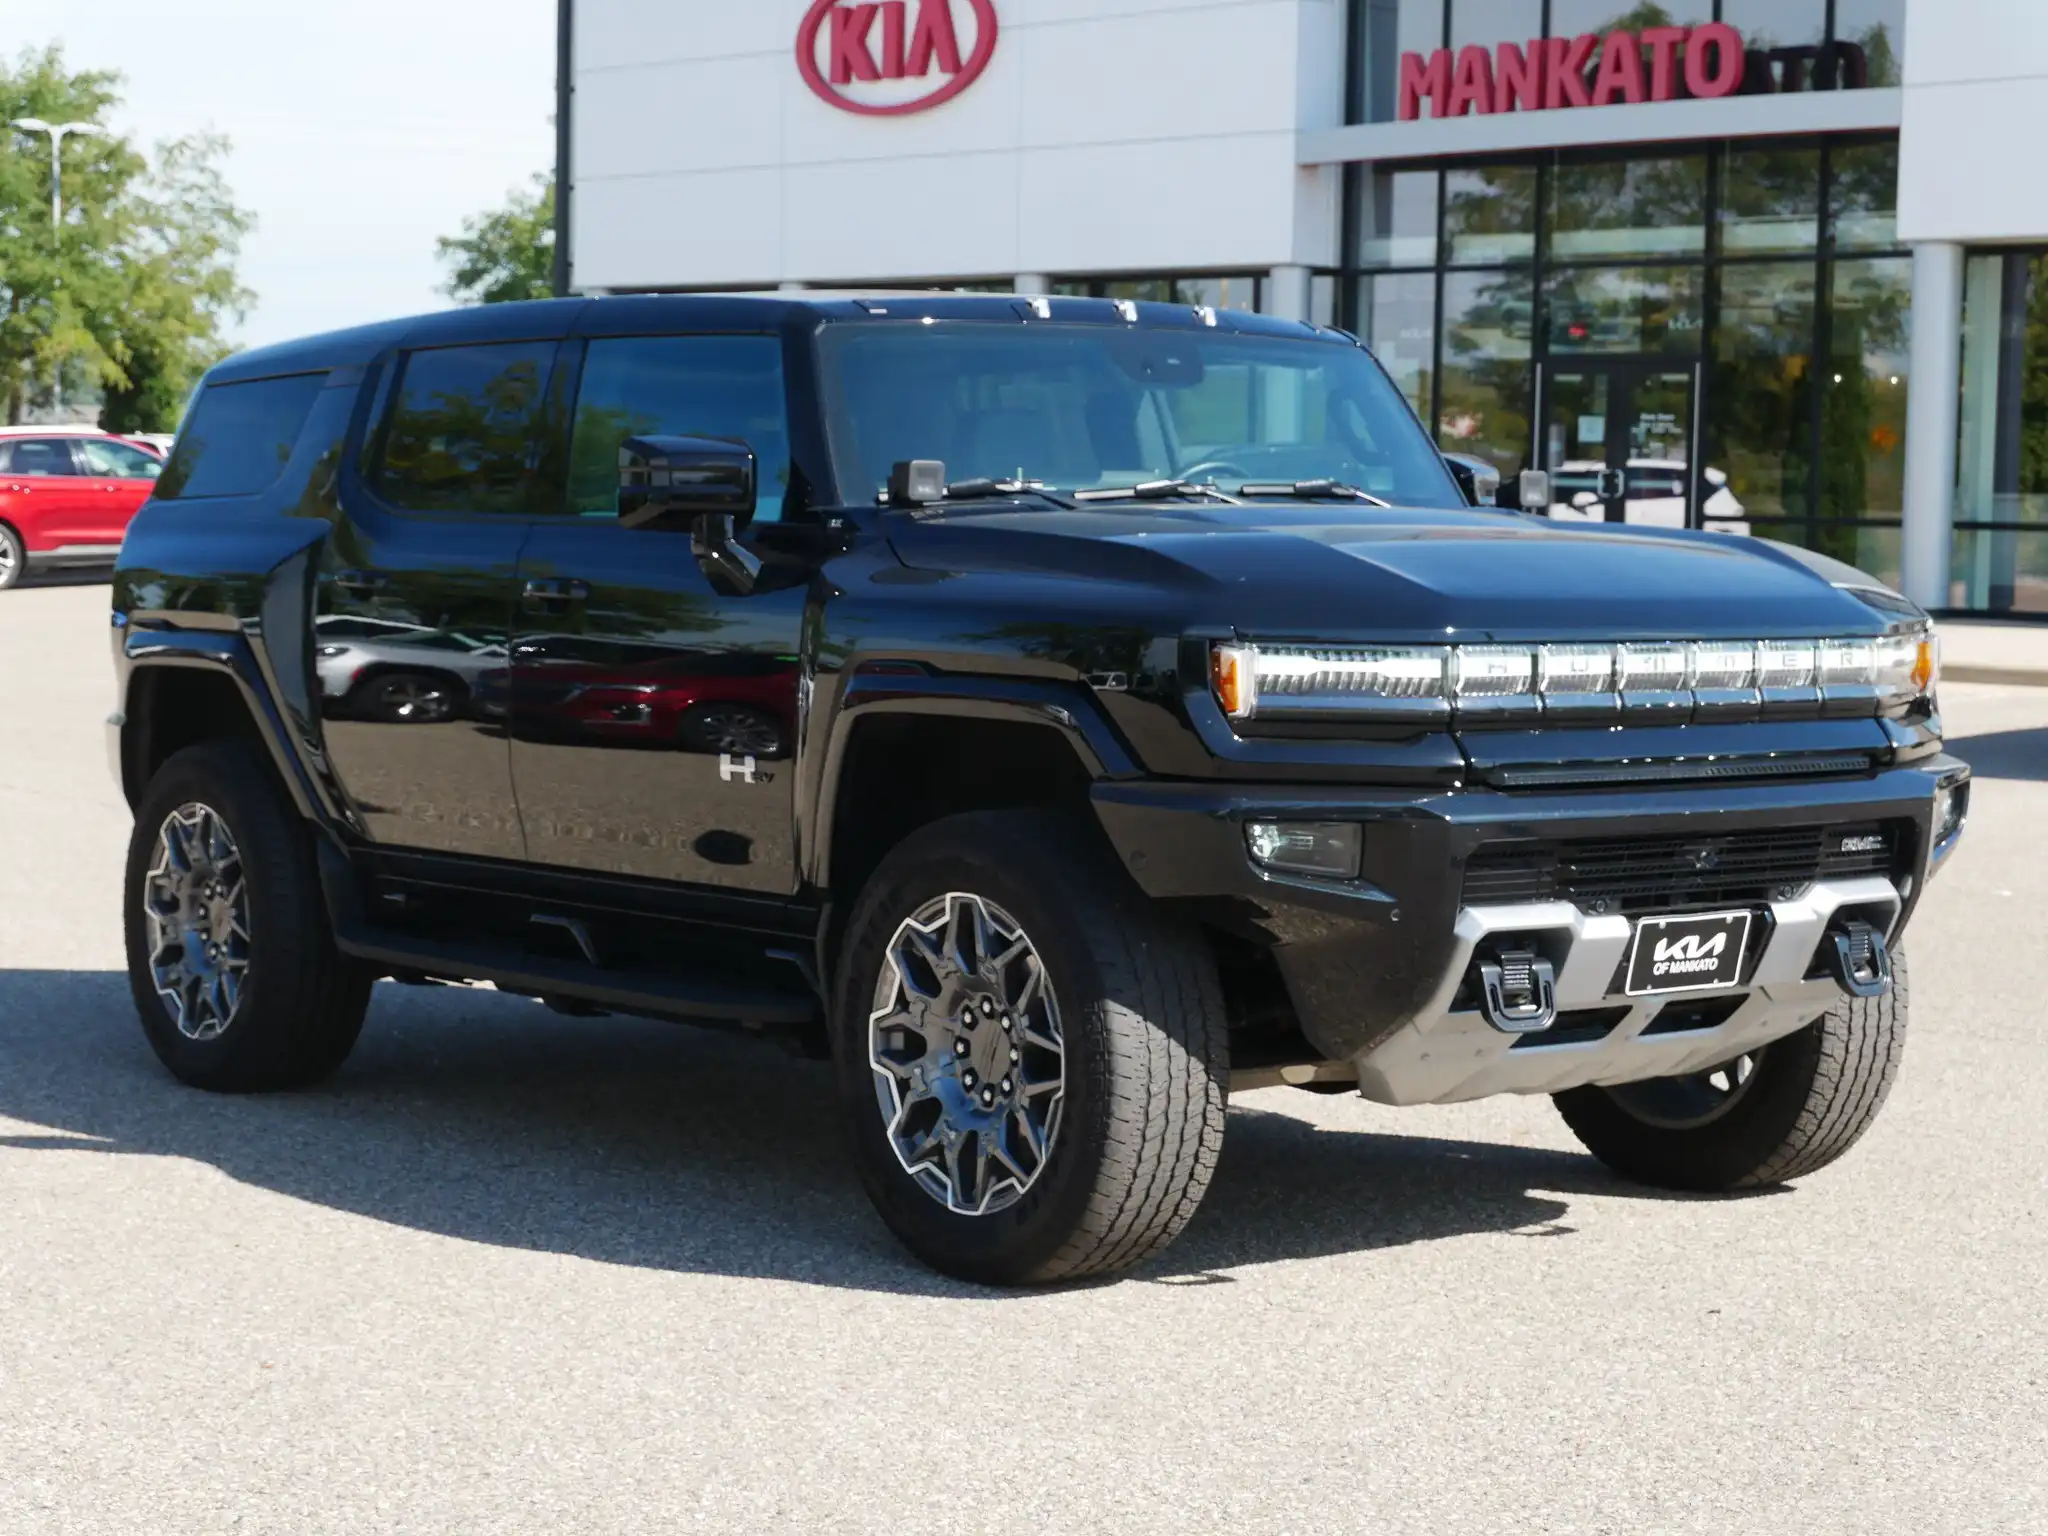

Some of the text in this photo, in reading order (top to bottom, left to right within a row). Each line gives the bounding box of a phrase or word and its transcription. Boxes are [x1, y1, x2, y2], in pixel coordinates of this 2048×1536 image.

[830, 0, 965, 84] KIA
[1399, 22, 1745, 121] MANKATO
[1653, 957, 1719, 976] OF MANKATO
